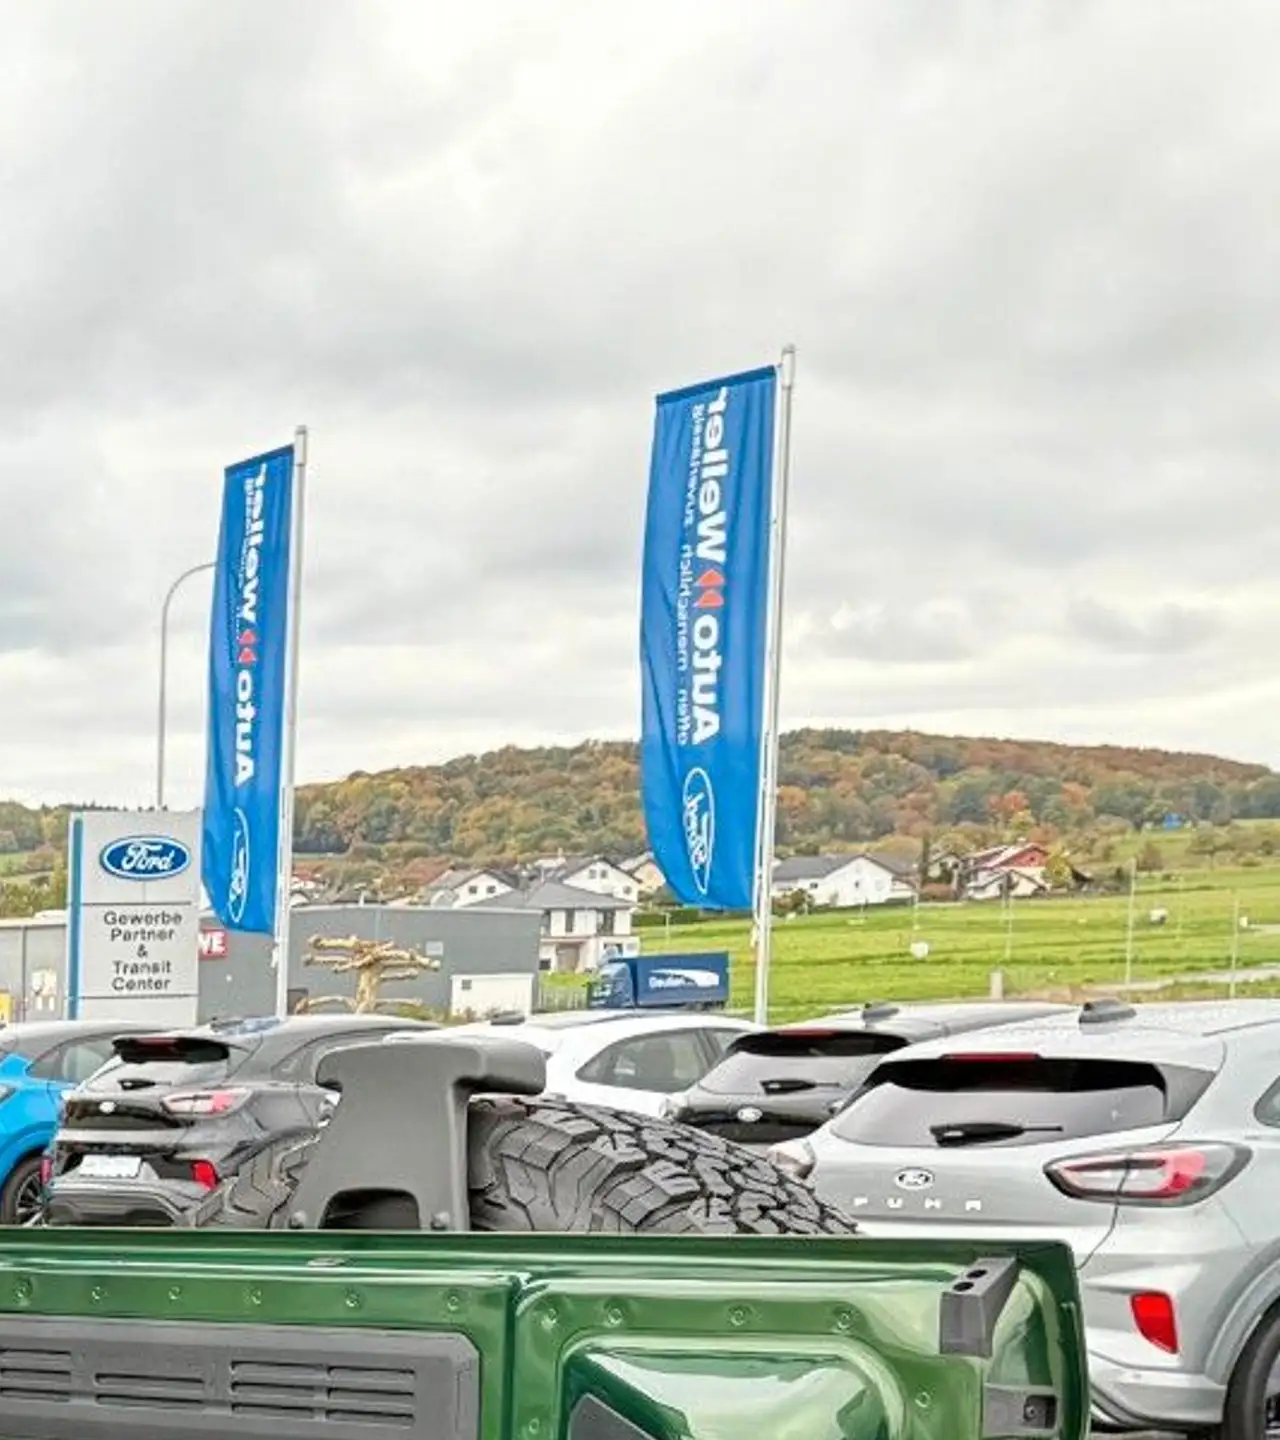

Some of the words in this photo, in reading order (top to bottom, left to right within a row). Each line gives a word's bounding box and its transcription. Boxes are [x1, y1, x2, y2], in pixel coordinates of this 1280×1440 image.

[103, 911, 182, 925] Gewerbe
[110, 928, 175, 942] Partner
[137, 944, 148, 958] &
[113, 961, 171, 974] Transit
[111, 977, 171, 991] Center
